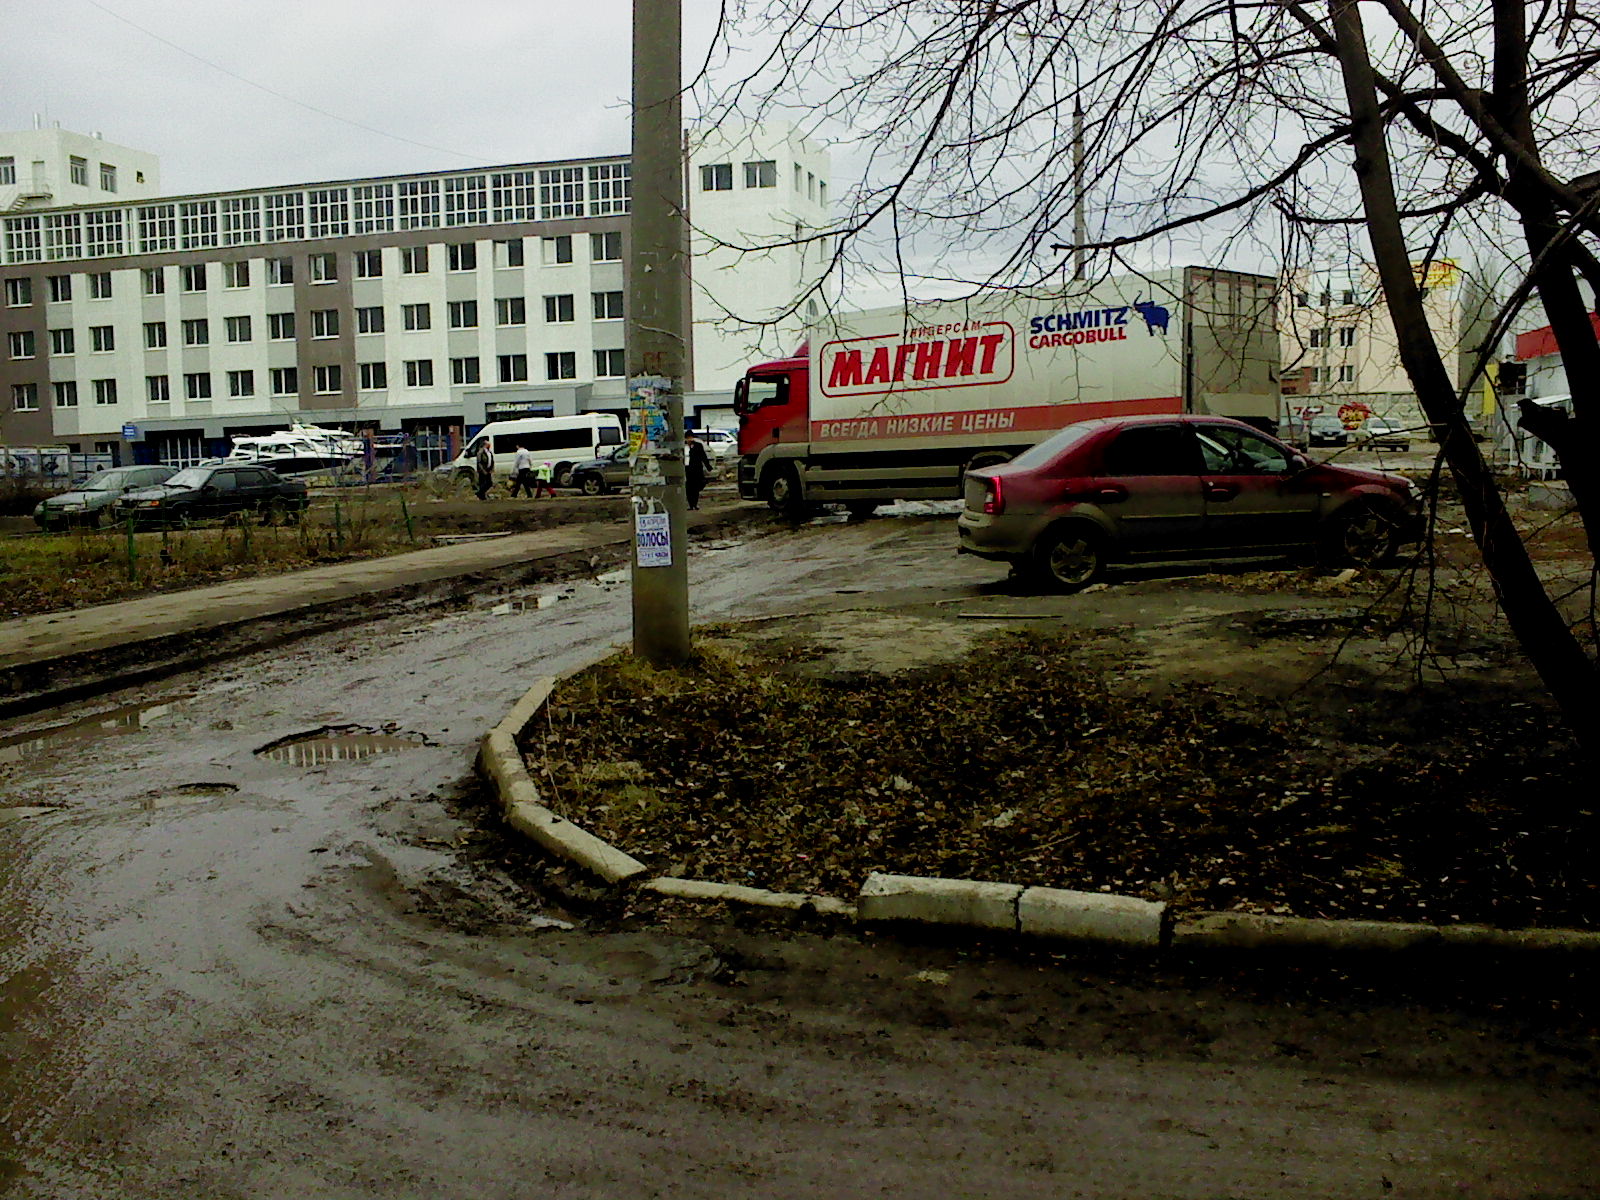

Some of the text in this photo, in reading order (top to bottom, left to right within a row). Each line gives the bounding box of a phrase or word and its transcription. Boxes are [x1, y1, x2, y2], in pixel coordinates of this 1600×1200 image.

[1030, 306, 1128, 334] SCHMITZ
[1029, 326, 1127, 349] CARGOBULL
[828, 334, 1004, 388] МАГНИТ
[820, 411, 1015, 438] ВСЕГДА НИЗКИЕ ЦЕНЫ
